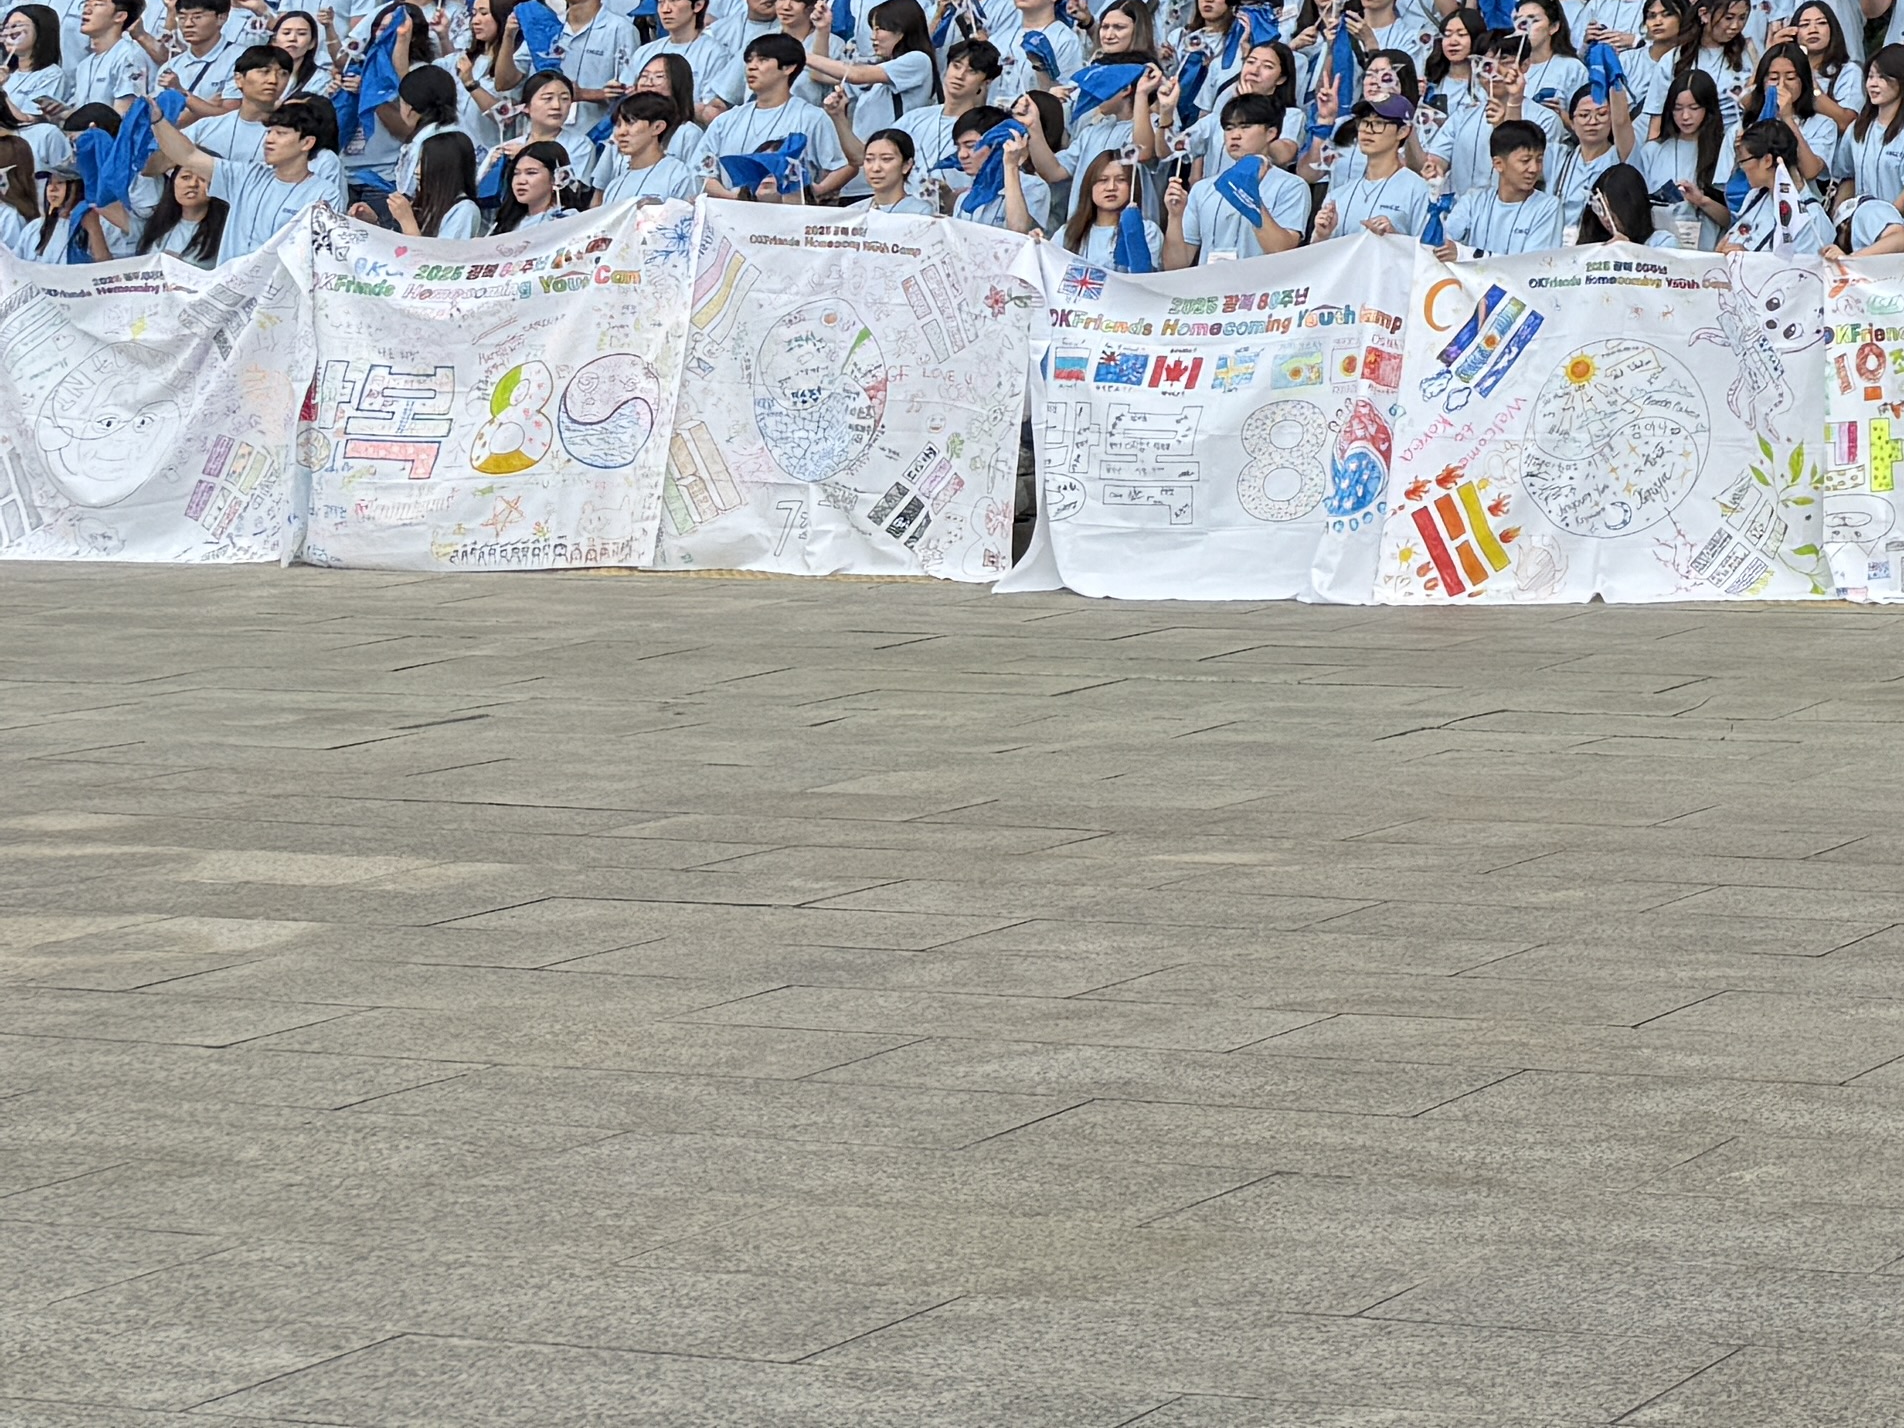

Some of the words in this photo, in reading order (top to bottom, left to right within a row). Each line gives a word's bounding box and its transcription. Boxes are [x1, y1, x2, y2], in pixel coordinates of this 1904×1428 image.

[413, 265, 465, 280] 2025
[594, 265, 642, 285] Cam
[1528, 277, 1582, 288] OKFriends
[1585, 275, 1663, 289] Homecoming
[1666, 277, 1701, 290] Youth
[1168, 296, 1219, 315] 2025
[1160, 313, 1293, 336] Homecoming
[1297, 303, 1356, 328] Youth
